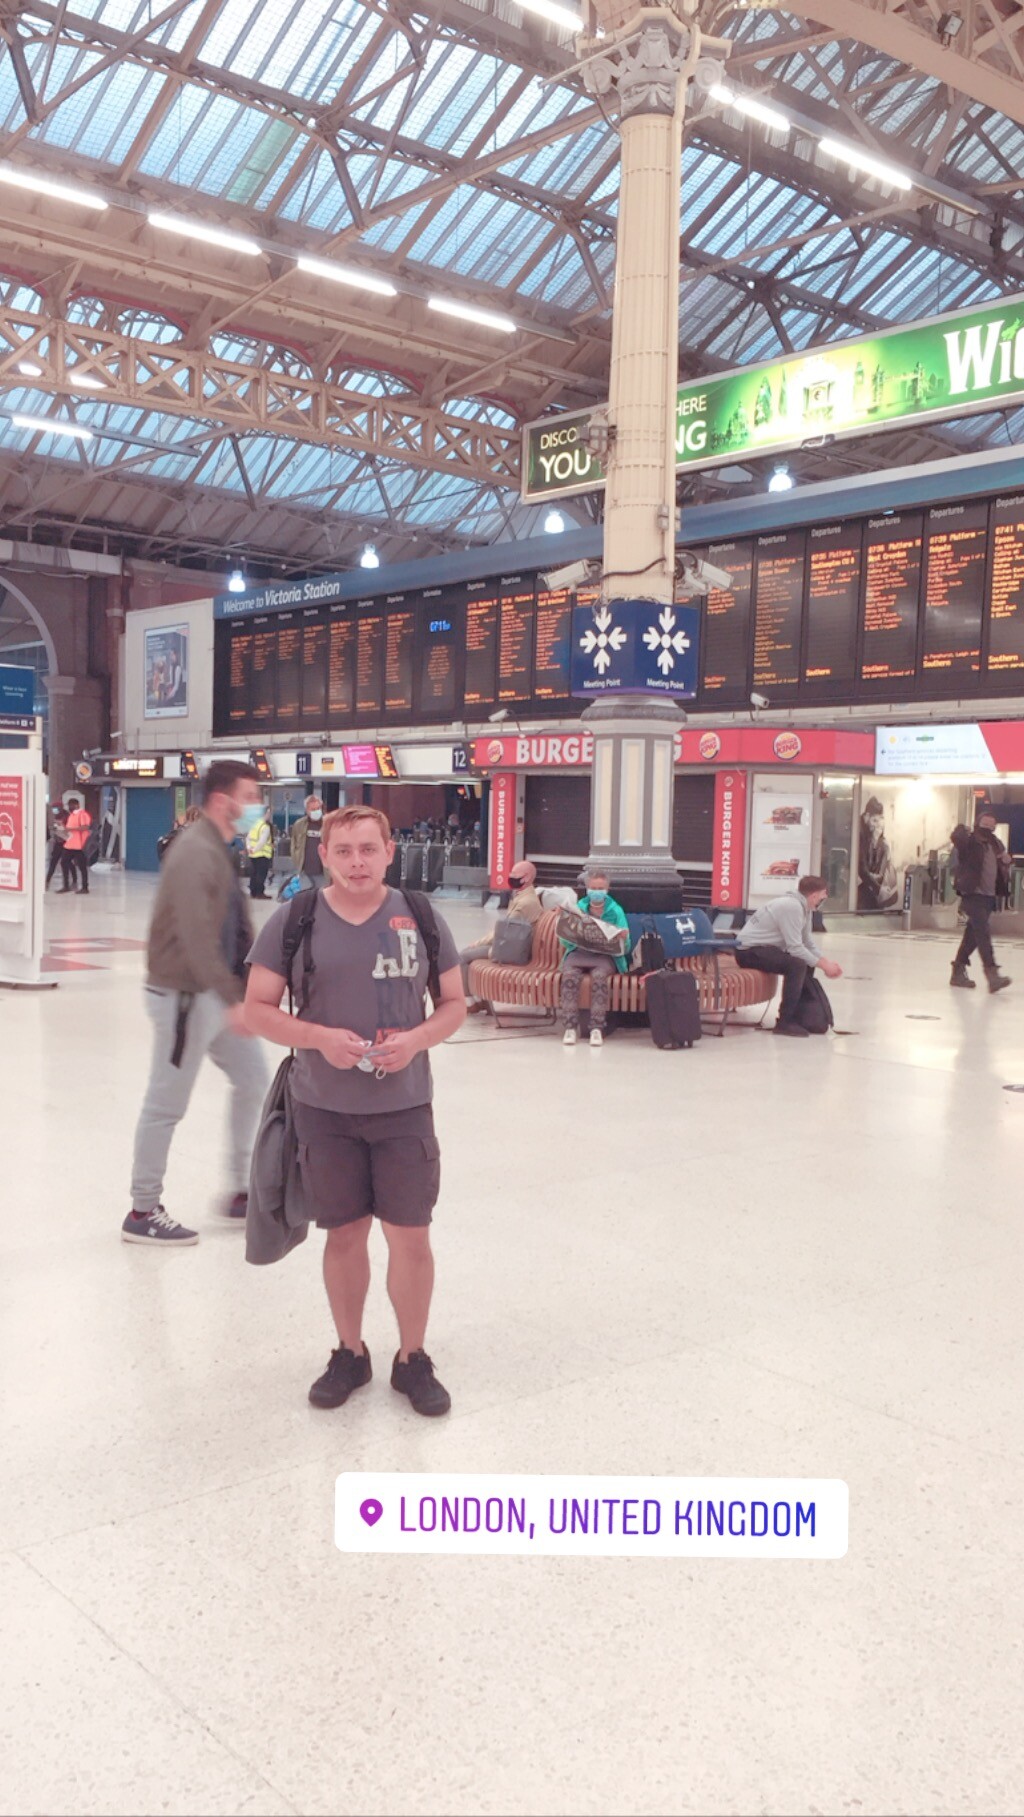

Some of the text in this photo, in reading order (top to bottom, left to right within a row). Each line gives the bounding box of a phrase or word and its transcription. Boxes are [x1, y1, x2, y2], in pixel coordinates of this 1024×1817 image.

[540, 426, 577, 450] DISCO
[929, 506, 965, 518] Departures
[868, 517, 901, 528] Departures
[811, 527, 842, 537] Departures
[223, 580, 341, 613] Welcome to Victoria Station
[922, 659, 952, 669] Southern
[987, 654, 1019, 664] Southern
[805, 668, 831, 677] Southern
[861, 665, 890, 674] Southern
[583, 678, 621, 689] Meeting Point
[646, 678, 685, 690] Meeting Point
[516, 737, 594, 764] BURGE
[298, 756, 306, 772] 11
[453, 751, 467, 768] 12
[496, 790, 506, 872] BURGER KING
[720, 791, 733, 887] BURGER KING
